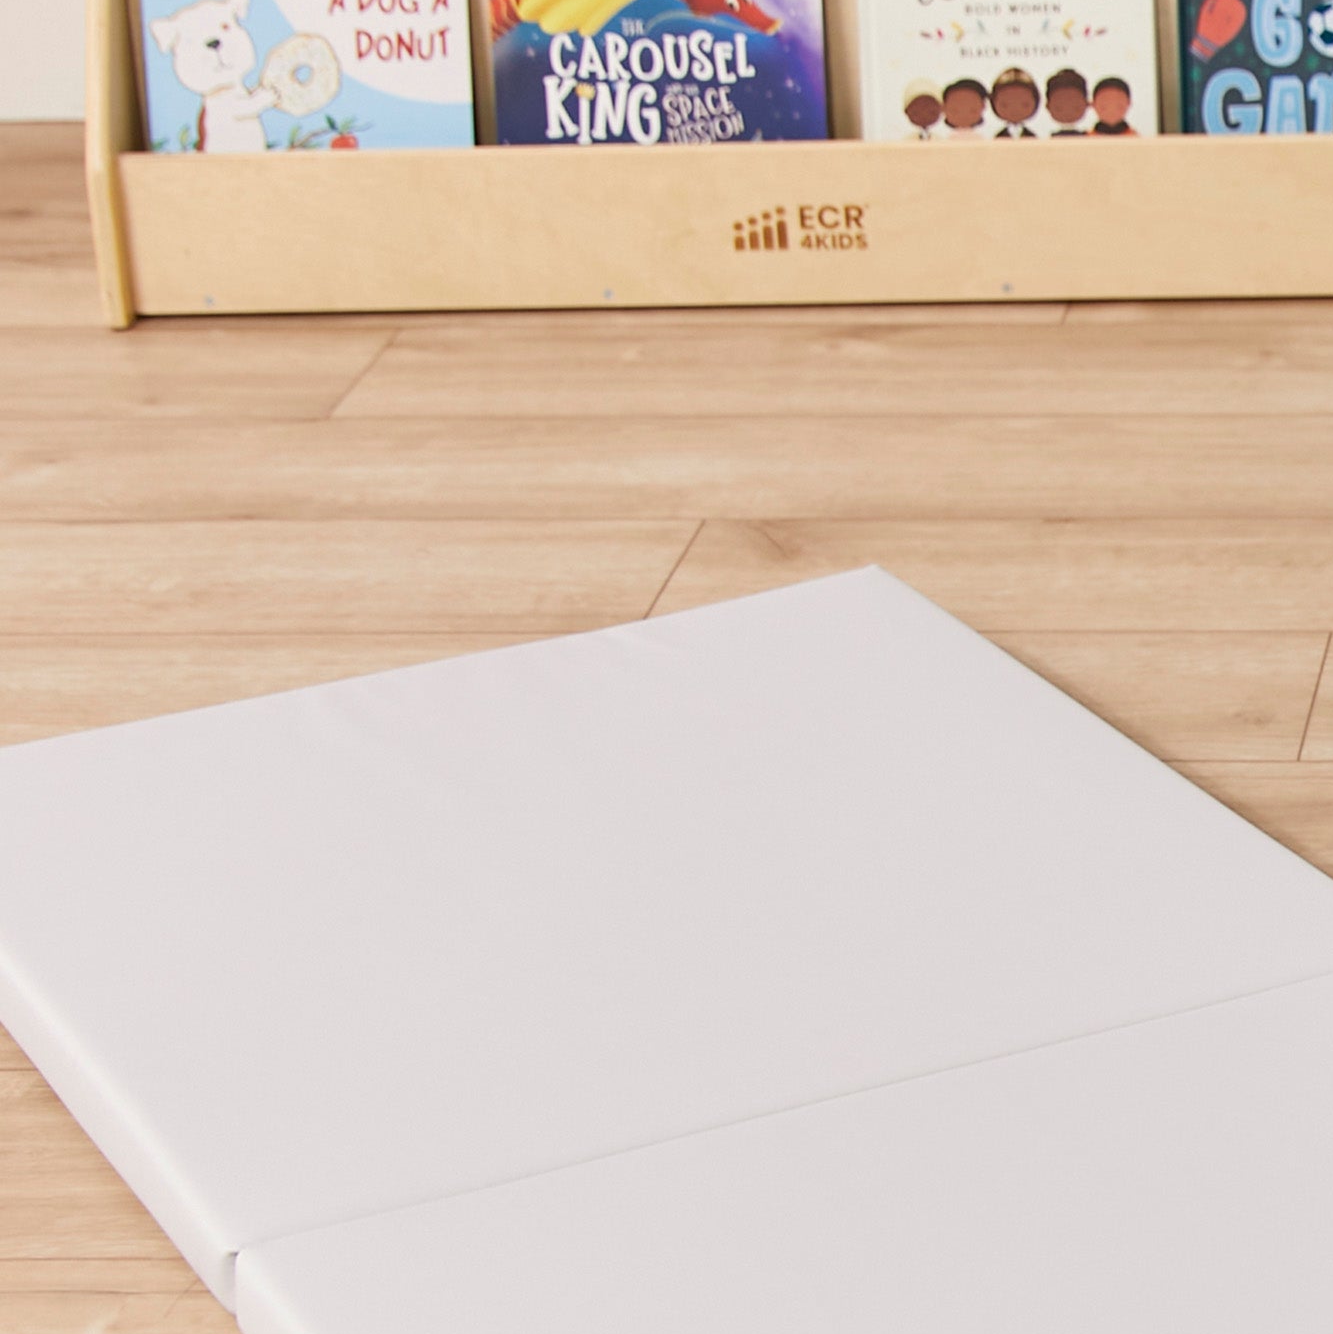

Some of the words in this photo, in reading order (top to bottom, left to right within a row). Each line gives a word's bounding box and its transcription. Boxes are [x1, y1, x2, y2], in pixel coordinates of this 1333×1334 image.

[355, 27, 452, 62] DONUT
[549, 29, 757, 84] CAROUSEL
[543, 75, 662, 146] KING
[661, 86, 736, 127] SPACE
[665, 111, 745, 144] MISSION
[798, 204, 865, 229] ECR
[800, 233, 869, 251] 4KIDS
